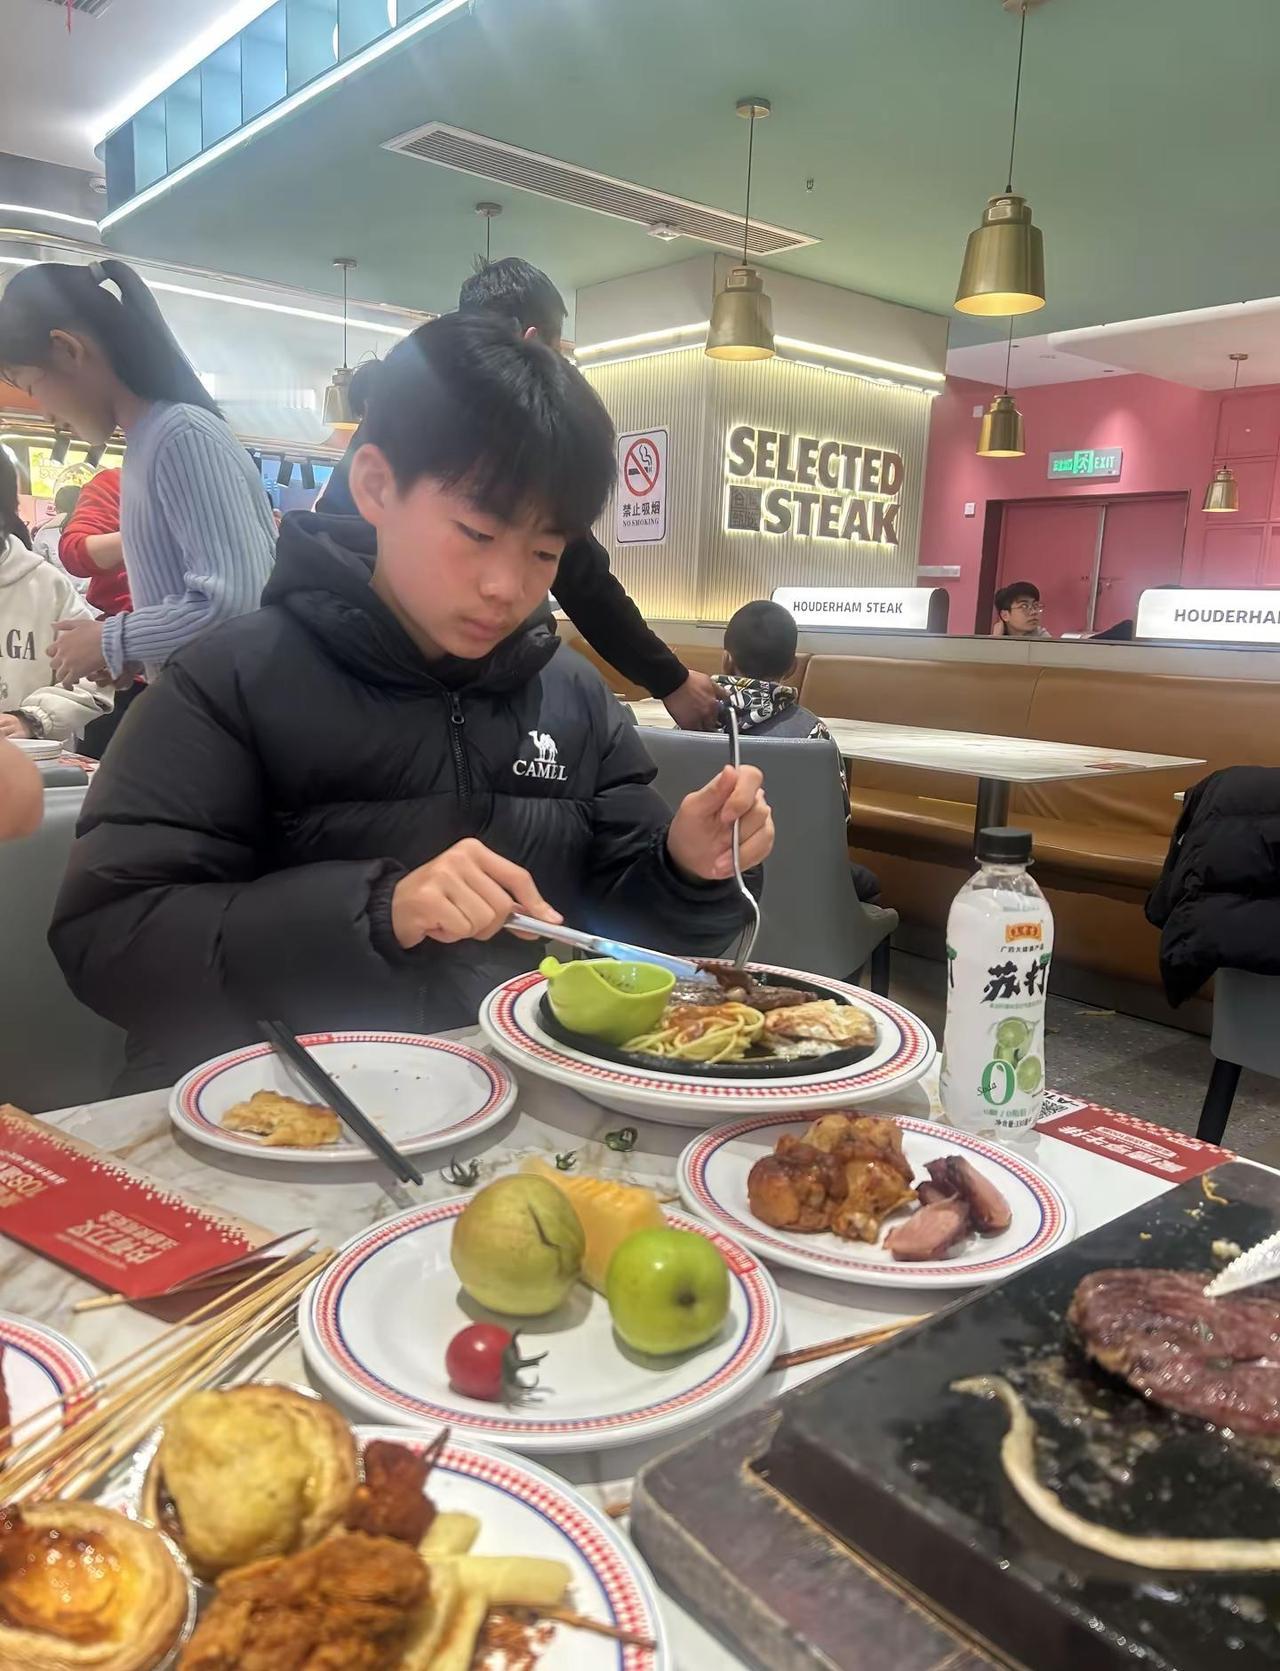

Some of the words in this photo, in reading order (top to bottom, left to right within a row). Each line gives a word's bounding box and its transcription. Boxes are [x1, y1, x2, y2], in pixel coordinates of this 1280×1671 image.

[729, 426, 904, 496] SELECTED
[1094, 455, 1115, 469] EXIT
[622, 500, 661, 518] 禁止吸烟
[764, 487, 901, 545] STEAK
[623, 519, 632, 527] NO
[632, 517, 660, 526] SMOKING
[793, 601, 862, 613] HOUDERHAM
[866, 602, 903, 613] STEAK
[1174, 608, 1280, 625] HOUDERHA
[0, 628, 36, 661] GA
[512, 759, 569, 781] CAMEL
[980, 959, 1049, 1004] 苏打
